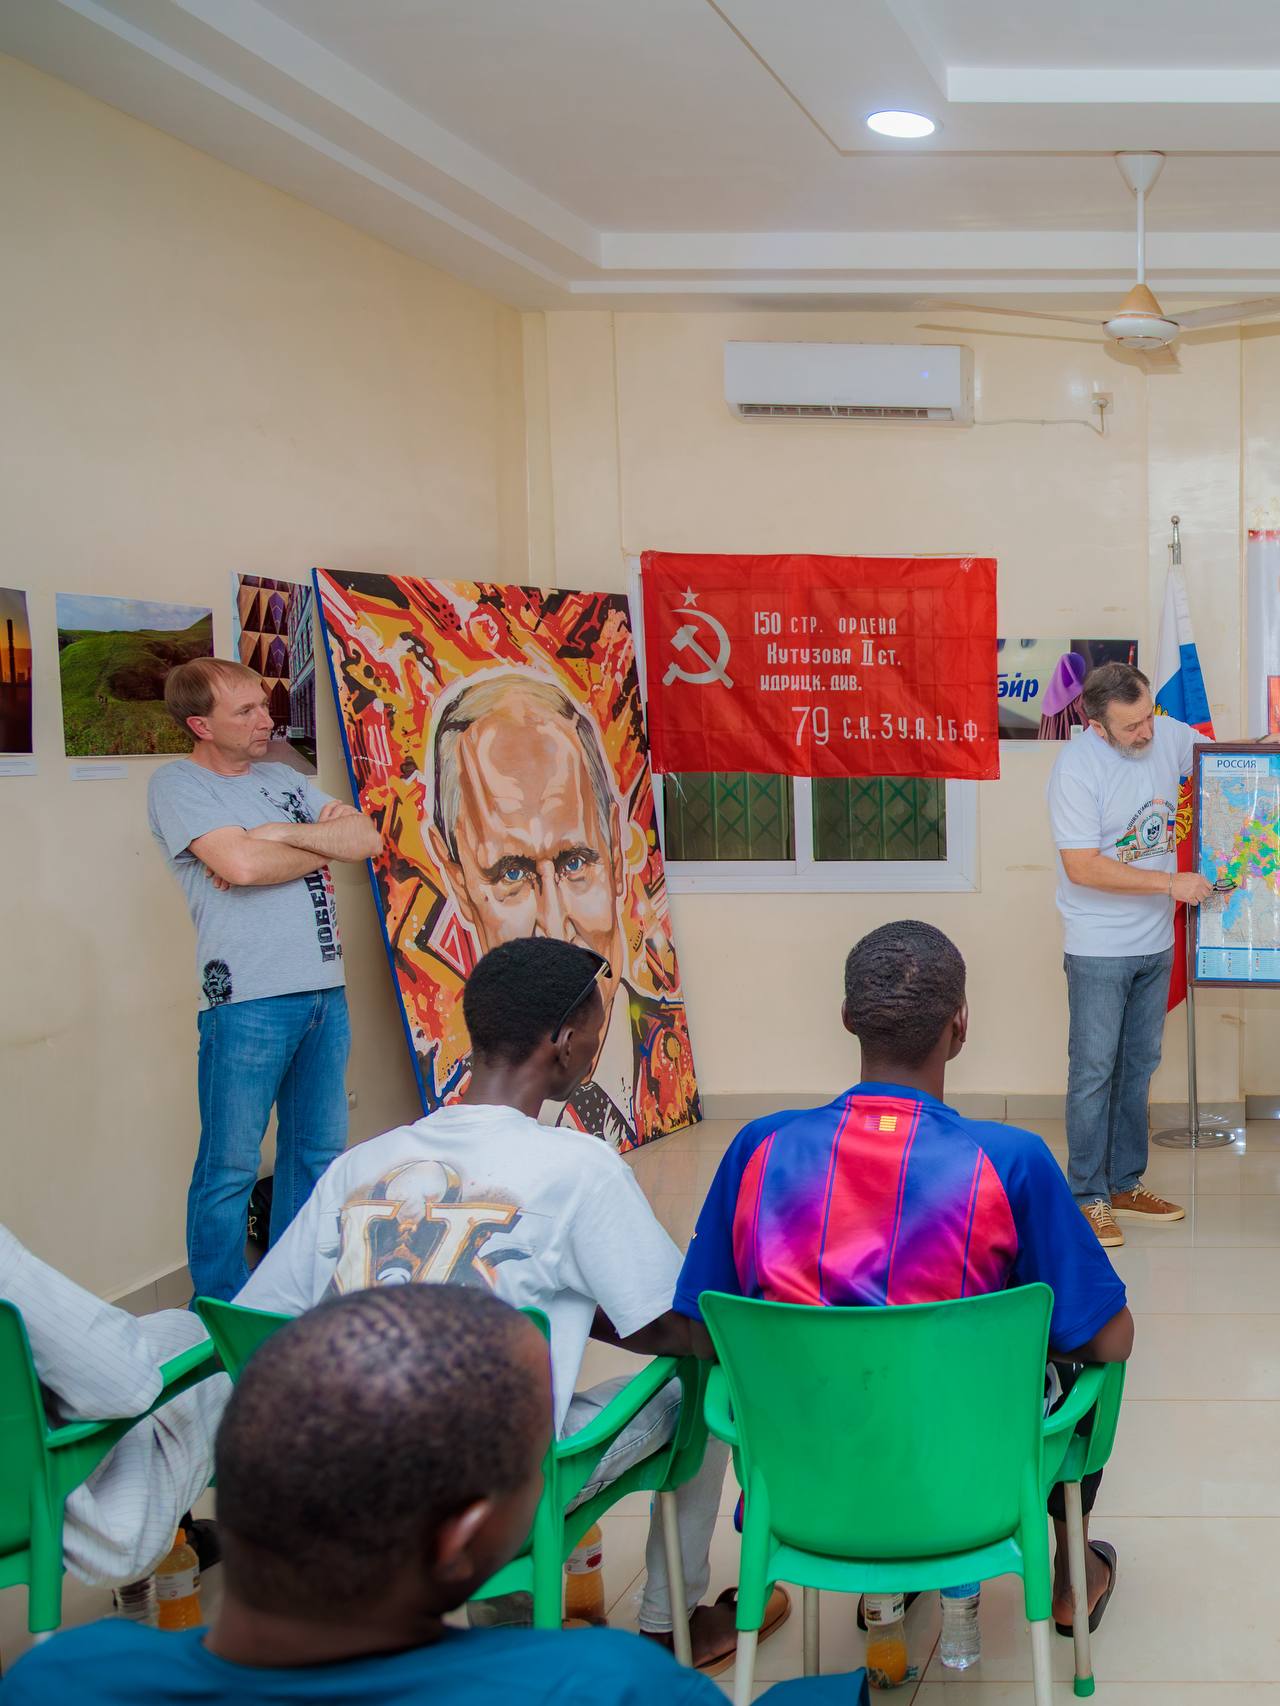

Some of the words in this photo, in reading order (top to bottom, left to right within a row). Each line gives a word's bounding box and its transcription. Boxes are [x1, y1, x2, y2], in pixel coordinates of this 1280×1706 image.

[754, 611, 782, 635] 150
[838, 617, 897, 635] ОРДЕНА
[791, 706, 830, 746] 79
[1217, 759, 1257, 769] РОССИЯ
[304, 868, 336, 963] ПОБЕД
